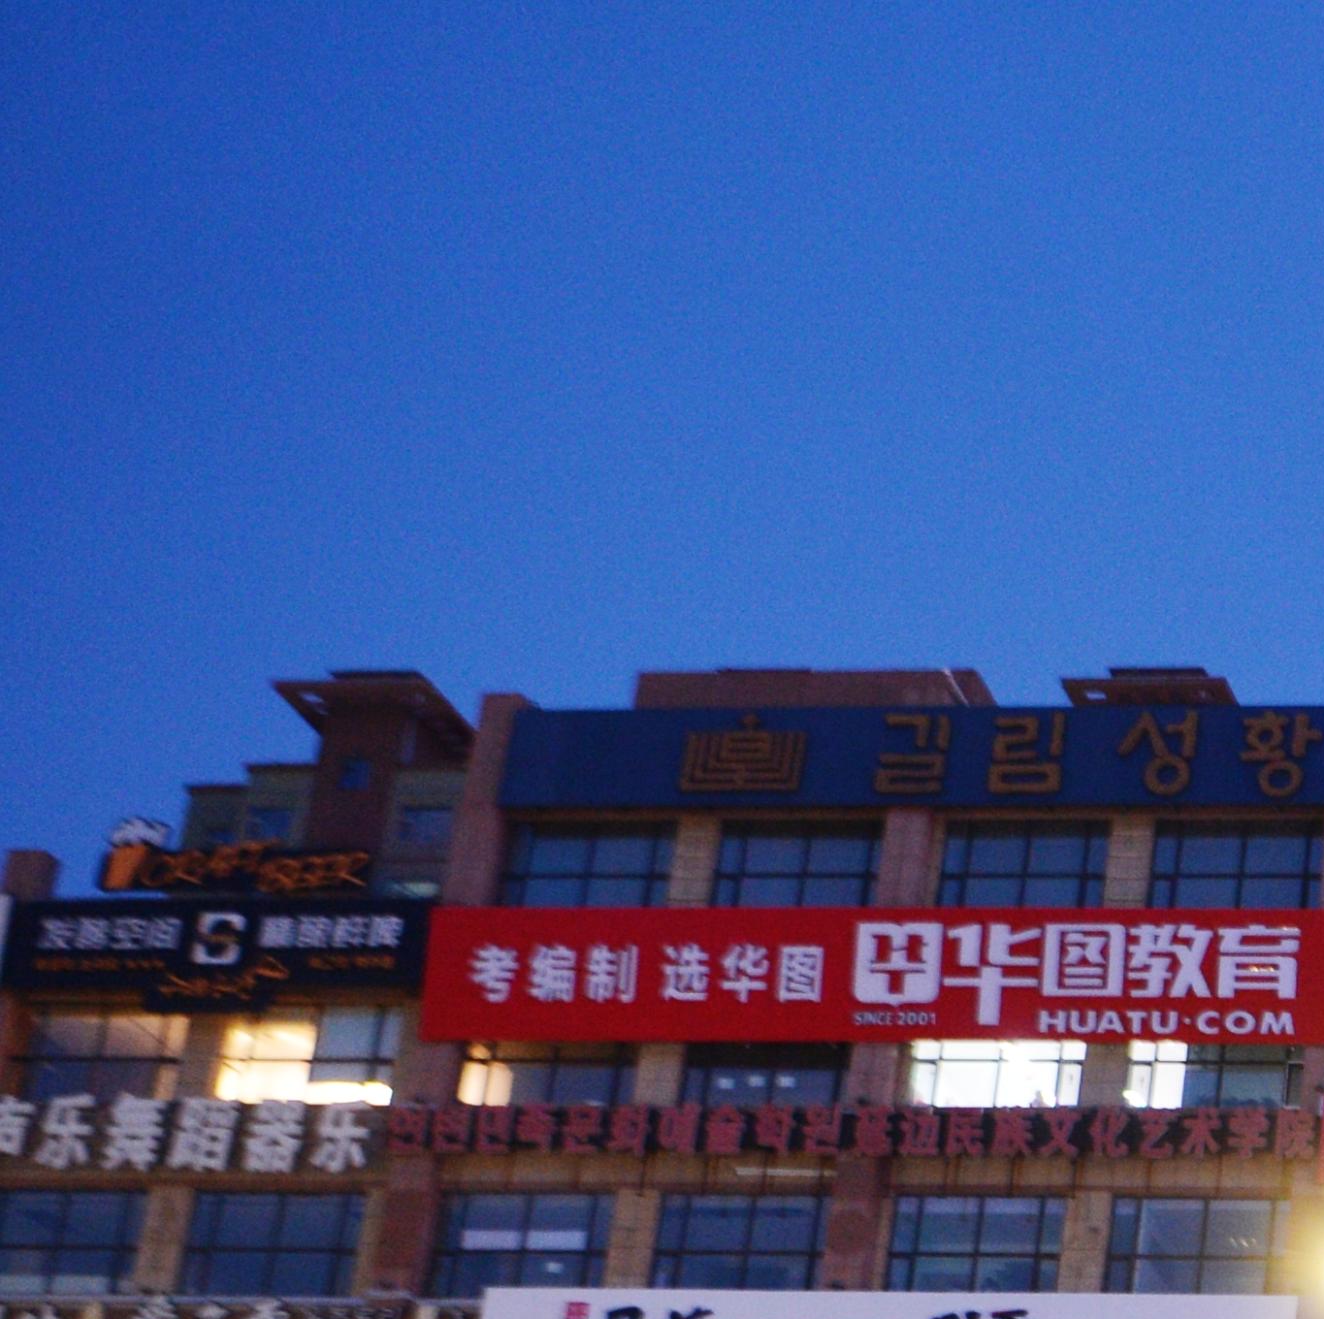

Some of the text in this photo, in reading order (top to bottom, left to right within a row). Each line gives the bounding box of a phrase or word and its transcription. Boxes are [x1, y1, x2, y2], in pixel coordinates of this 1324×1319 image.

[469, 923, 1301, 1026] 考编制 选华图 华图教育
